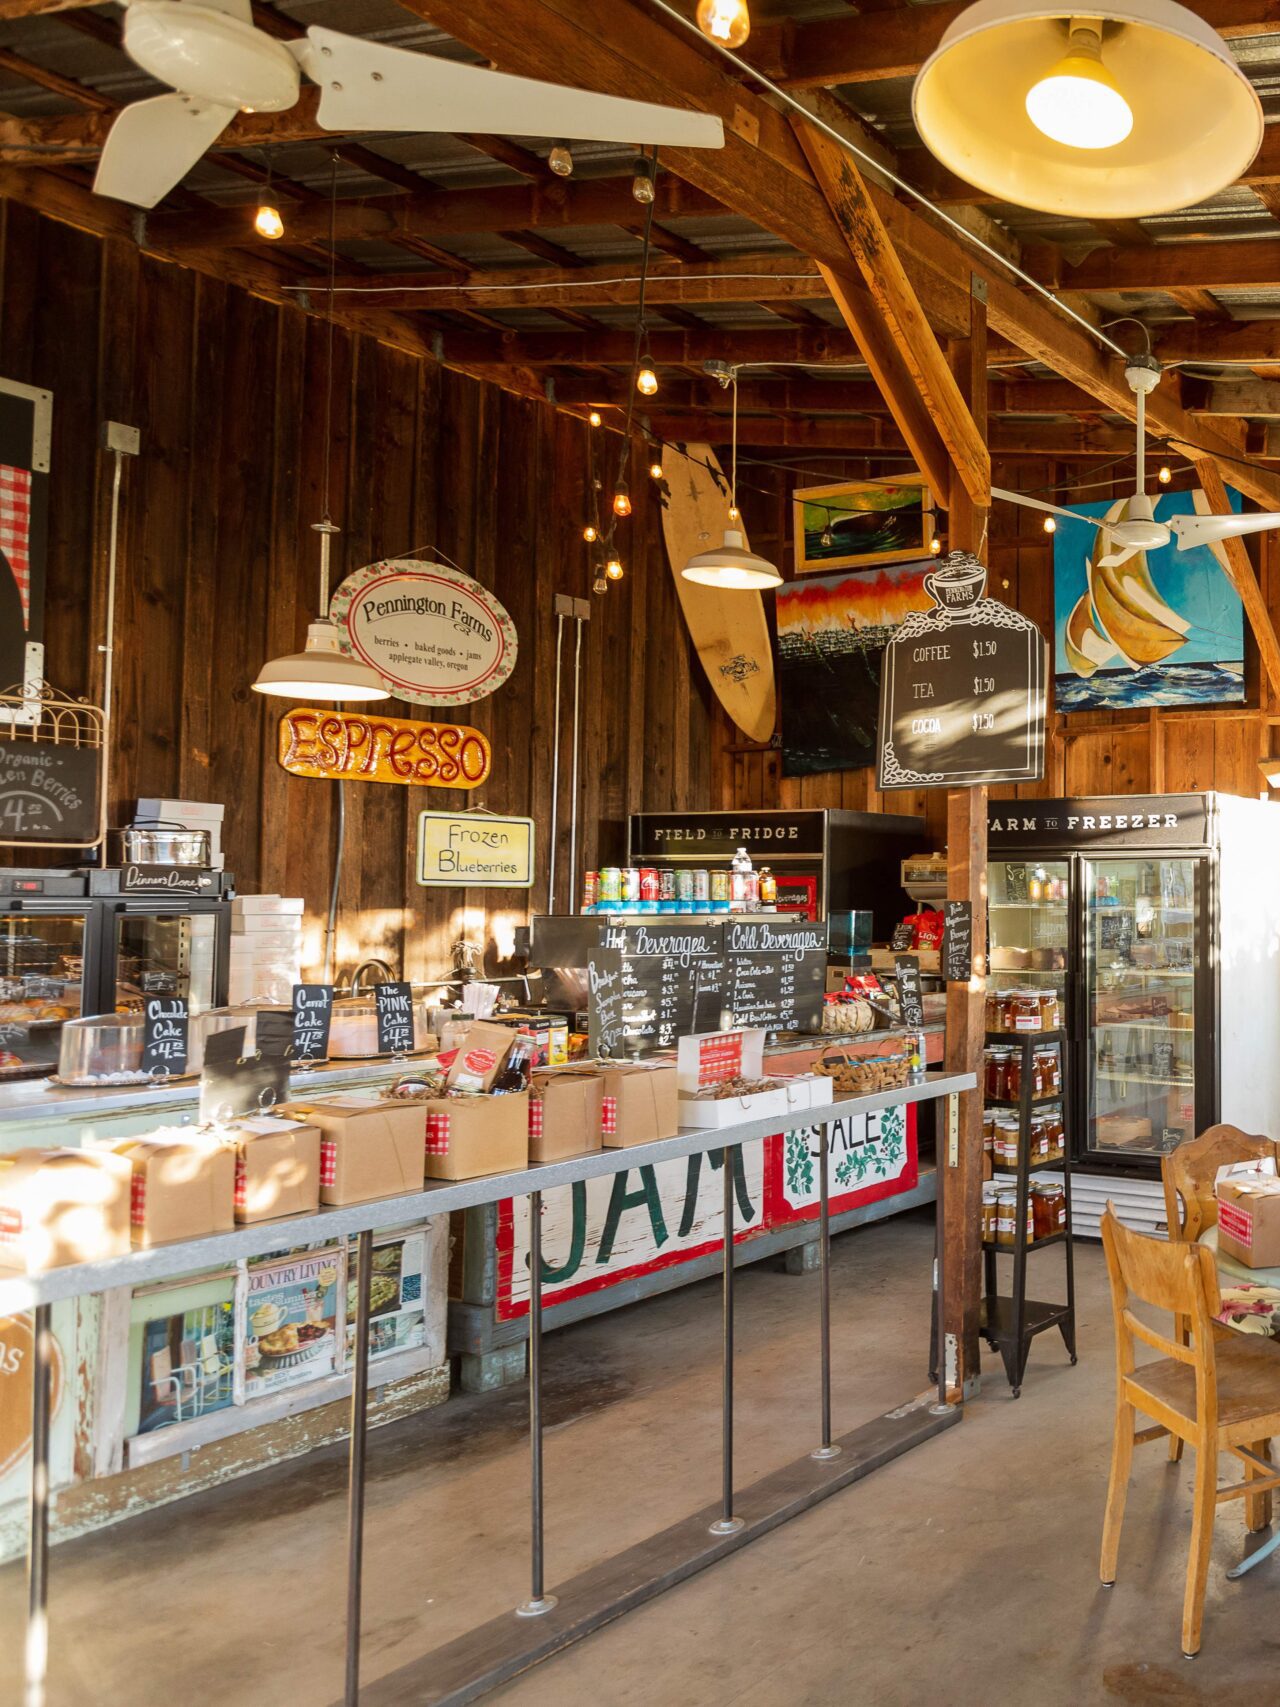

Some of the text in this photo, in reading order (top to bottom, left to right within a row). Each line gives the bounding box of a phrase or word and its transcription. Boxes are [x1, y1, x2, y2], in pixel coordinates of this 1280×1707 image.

[946, 590, 974, 603] FARMS
[363, 594, 493, 643] Pennington Farms
[374, 635, 482, 661] berries baked goods jams
[913, 640, 997, 663] COFFEE $1.50
[388, 652, 469, 673] applegate valley, oregon
[912, 677, 995, 699] TEA $1.50
[911, 713, 994, 735] COCOA $1.50
[31, 768, 82, 810] Berries
[654, 828, 706, 840] FIELD
[729, 826, 798, 840] FRIDGE
[987, 814, 1178, 831] ARM TO FREEZER
[448, 824, 509, 848] Frozen
[438, 849, 518, 874] Blueberries
[636, 927, 710, 968] Beverages
[732, 924, 822, 961] Cold Beverages
[918, 932, 939, 941] LION
[296, 988, 329, 1010] Carrot
[380, 985, 399, 995] The
[152, 1020, 183, 1040] Cake
[294, 1011, 324, 1028] Cake
[383, 1012, 409, 1028] Cake
